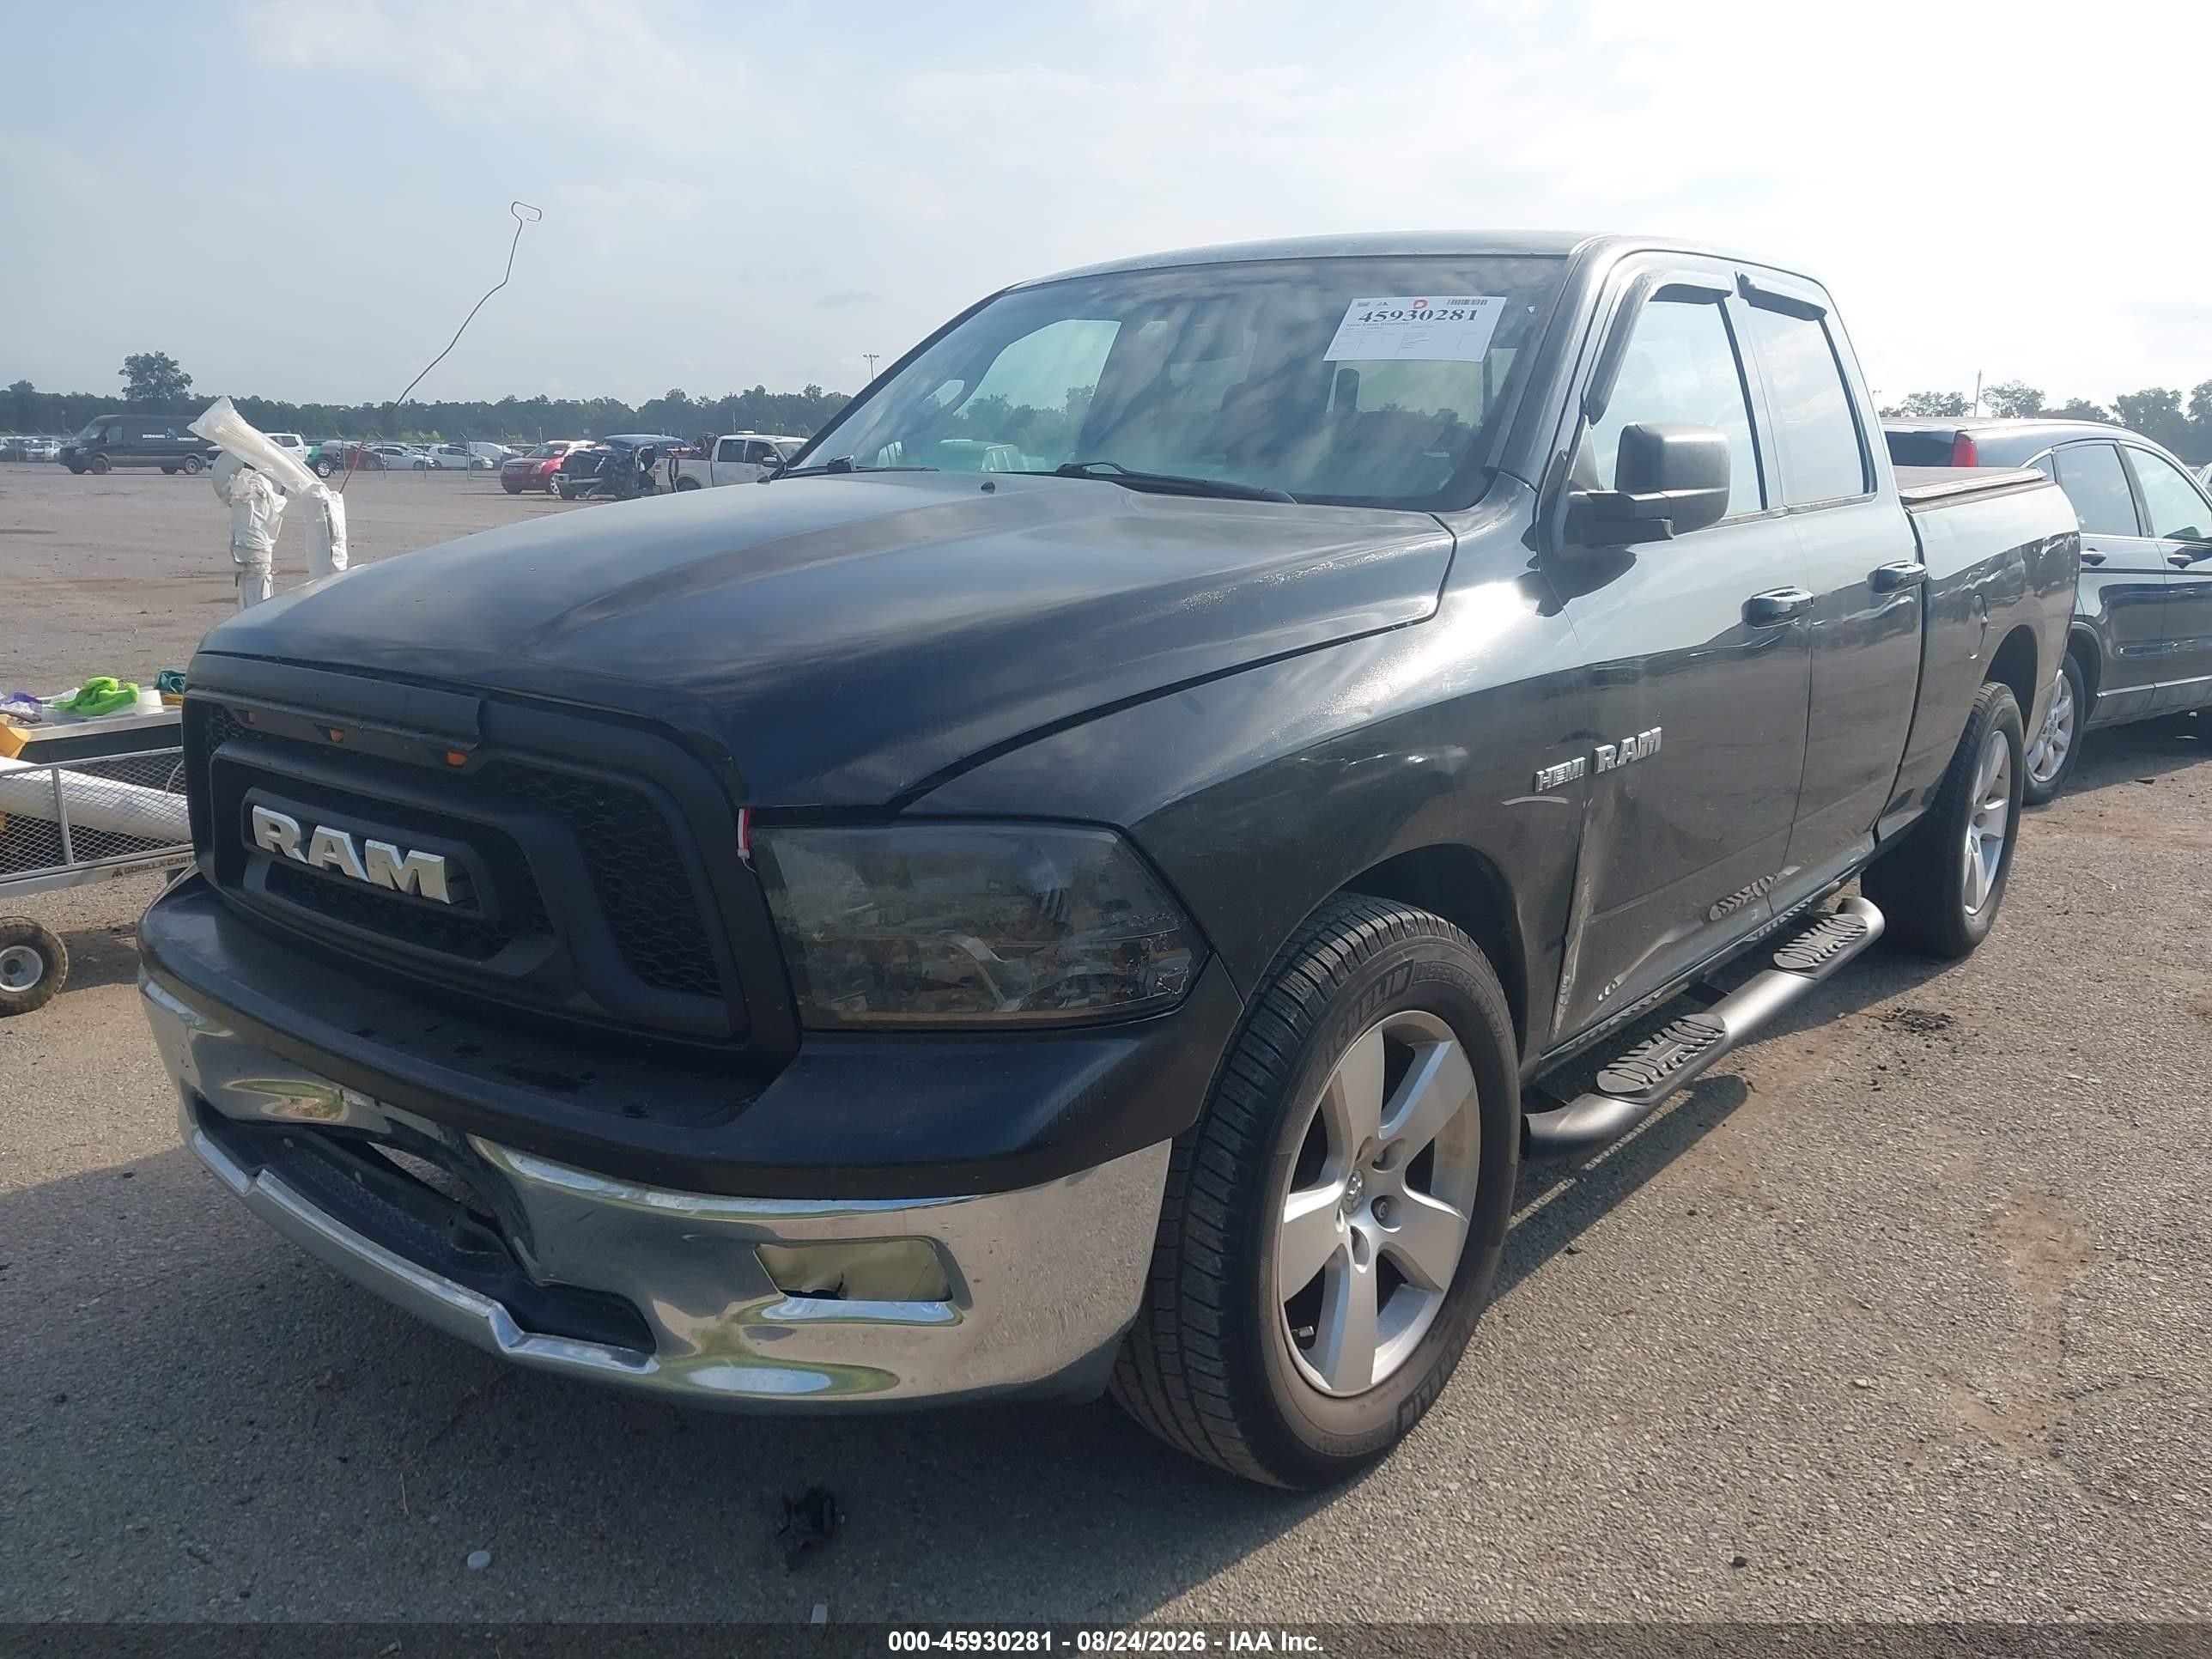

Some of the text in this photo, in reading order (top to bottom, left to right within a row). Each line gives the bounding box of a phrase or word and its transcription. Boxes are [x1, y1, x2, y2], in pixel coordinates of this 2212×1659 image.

[1358, 308, 1478, 323] 45930281
[1593, 726, 1662, 775] RAM
[1534, 757, 1586, 793] HEMI
[251, 805, 452, 904] RAM
